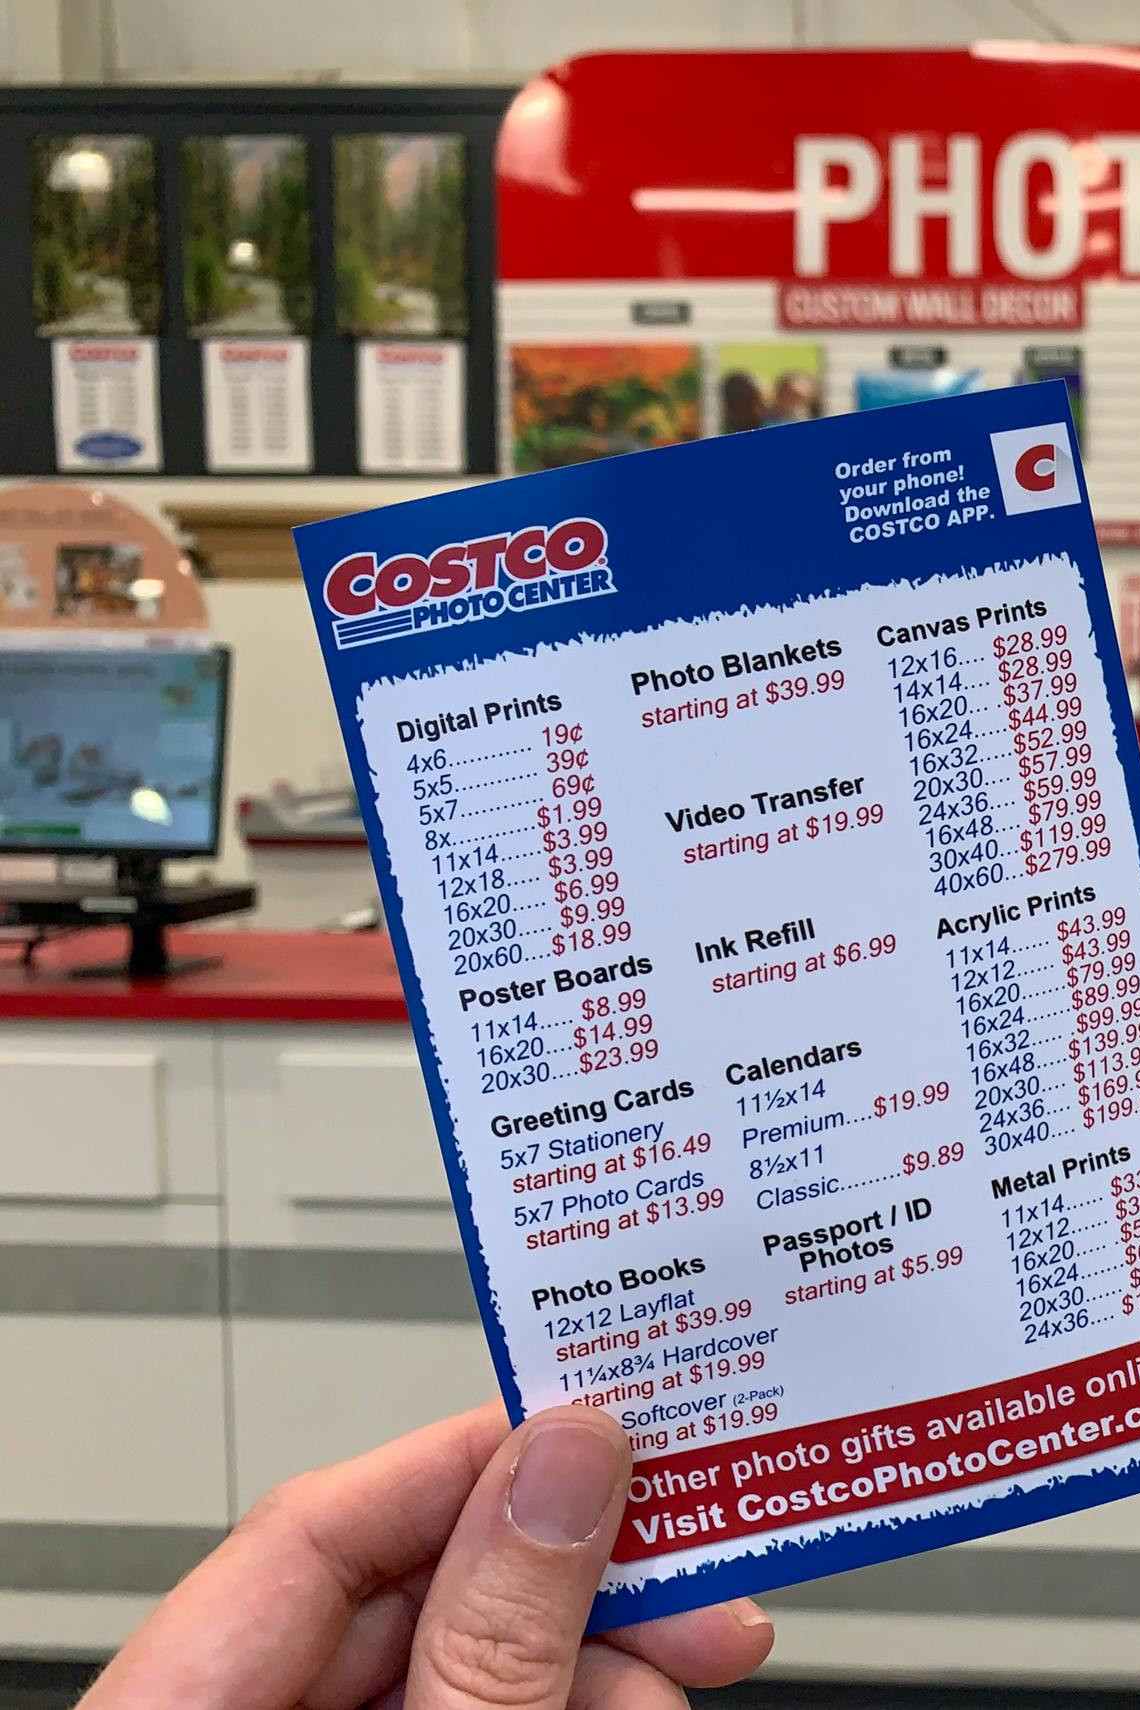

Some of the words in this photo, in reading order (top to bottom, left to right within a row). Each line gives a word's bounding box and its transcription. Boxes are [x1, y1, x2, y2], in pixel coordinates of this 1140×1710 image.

[834, 457, 897, 480] Order
[902, 448, 952, 469] from
[839, 480, 888, 506] your
[893, 464, 965, 497] phone!
[1015, 444, 1055, 492] C
[844, 489, 950, 523] Download
[956, 485, 991, 504] the
[849, 513, 941, 544] COSTCO
[946, 504, 995, 527] APP.
[325, 519, 606, 617] COSTCO
[413, 591, 504, 629] PHOTO
[508, 569, 611, 608] CENTER
[876, 615, 971, 647] Canvas
[975, 599, 1048, 629] Prints
[630, 663, 715, 696] Photo
[720, 638, 843, 679] Blankets
[887, 646, 957, 679] 12x16
[992, 624, 1068, 660] $28.99
[396, 706, 479, 743] Digital
[483, 693, 563, 725] Prints
[641, 696, 729, 729] starting
[736, 688, 759, 710] at
[765, 669, 845, 705] $39.99
[898, 695, 968, 728] 16x20
[1003, 672, 1077, 708] $37.99
[406, 748, 447, 775] 4x6
[413, 773, 453, 801] 5x5
[537, 796, 602, 830] $1.99
[664, 803, 746, 833] Video
[750, 776, 865, 815] Transfer
[918, 791, 989, 826] 24x36
[1023, 766, 1097, 804] $59.99
[431, 842, 499, 875] 11x14
[542, 821, 608, 855] $3.99
[683, 832, 769, 864] starting
[777, 823, 800, 845] at
[805, 803, 884, 840] $19.99
[929, 838, 999, 873] 30x40
[1020, 813, 1107, 854] $119.99
[933, 862, 1004, 896] 40x60
[1025, 836, 1111, 877] $279.99
[443, 893, 511, 925] 16x20
[554, 871, 619, 905] $6.99
[936, 903, 1022, 940] Acrylic
[1026, 885, 1097, 917] Prints
[453, 943, 523, 976] 20x60
[551, 920, 632, 958] $18.99
[694, 936, 740, 964] Ink
[744, 917, 816, 953] Refill
[712, 961, 797, 994] starting
[804, 951, 827, 973] at
[833, 933, 896, 968] $6.99
[945, 935, 1010, 969] 11x14
[1056, 906, 1126, 943] $43.99
[458, 978, 547, 1012] Poster
[553, 954, 653, 993] Boards
[955, 982, 1021, 1016] 16x20
[1066, 951, 1136, 989] $79.99
[471, 1010, 539, 1043] 11x14
[581, 988, 646, 1022] $8.99
[481, 1061, 550, 1095] 20x30
[579, 1038, 659, 1075] $23.99
[725, 1040, 863, 1086] Calendars
[966, 1028, 1030, 1063] 16x32
[490, 1099, 608, 1138] Greeting
[613, 1078, 695, 1112] Cards
[742, 1111, 845, 1150] Premium
[873, 1081, 950, 1119] $19.99
[974, 1075, 1040, 1111] 20x30
[500, 1143, 540, 1170] 5x7
[548, 1121, 664, 1160] Stationery
[512, 1162, 597, 1194] starting
[604, 1153, 627, 1175] at
[632, 1132, 712, 1170] $16.49
[984, 1121, 1050, 1156] 30x40
[514, 1199, 554, 1227] 5x7
[562, 1188, 630, 1217] Photo
[635, 1169, 705, 1200] Cards
[756, 1175, 840, 1210] Classic
[902, 1141, 964, 1177] $9.89
[990, 1163, 1057, 1200] Metal
[1061, 1146, 1131, 1180] Prints
[526, 1218, 610, 1250] starting
[618, 1208, 640, 1230] at
[646, 1187, 724, 1225] $13.99
[762, 1210, 884, 1257] Passport
[904, 1197, 932, 1223] ID
[1001, 1193, 1065, 1229] 11x14
[784, 1273, 867, 1305] starting
[873, 1264, 896, 1286] at
[901, 1245, 963, 1280] $5.99
[798, 1237, 895, 1273] Photos
[1011, 1239, 1075, 1275] 16x20
[531, 1279, 613, 1311] Photo
[618, 1257, 706, 1291] Books
[1019, 1285, 1084, 1322] 20x30
[544, 1307, 613, 1340] 12x12
[619, 1289, 696, 1323] Layflat
[556, 1329, 640, 1363] starting
[647, 1319, 670, 1340] at
[675, 1298, 752, 1335] $39.99
[1024, 1308, 1089, 1345] 24x36
[661, 1370, 684, 1391] at
[689, 1350, 765, 1386] $19.99
[662, 1327, 779, 1367] Hardcover
[621, 1393, 727, 1430] Softcover
[732, 1384, 785, 1408] (2-Pack)
[675, 1421, 697, 1441] at
[702, 1402, 778, 1436] $19.99
[626, 1464, 721, 1504] Other
[731, 1442, 831, 1489] photo
[840, 1423, 916, 1465] gifts
[926, 1383, 1077, 1441] available
[632, 1502, 728, 1545] Visit
